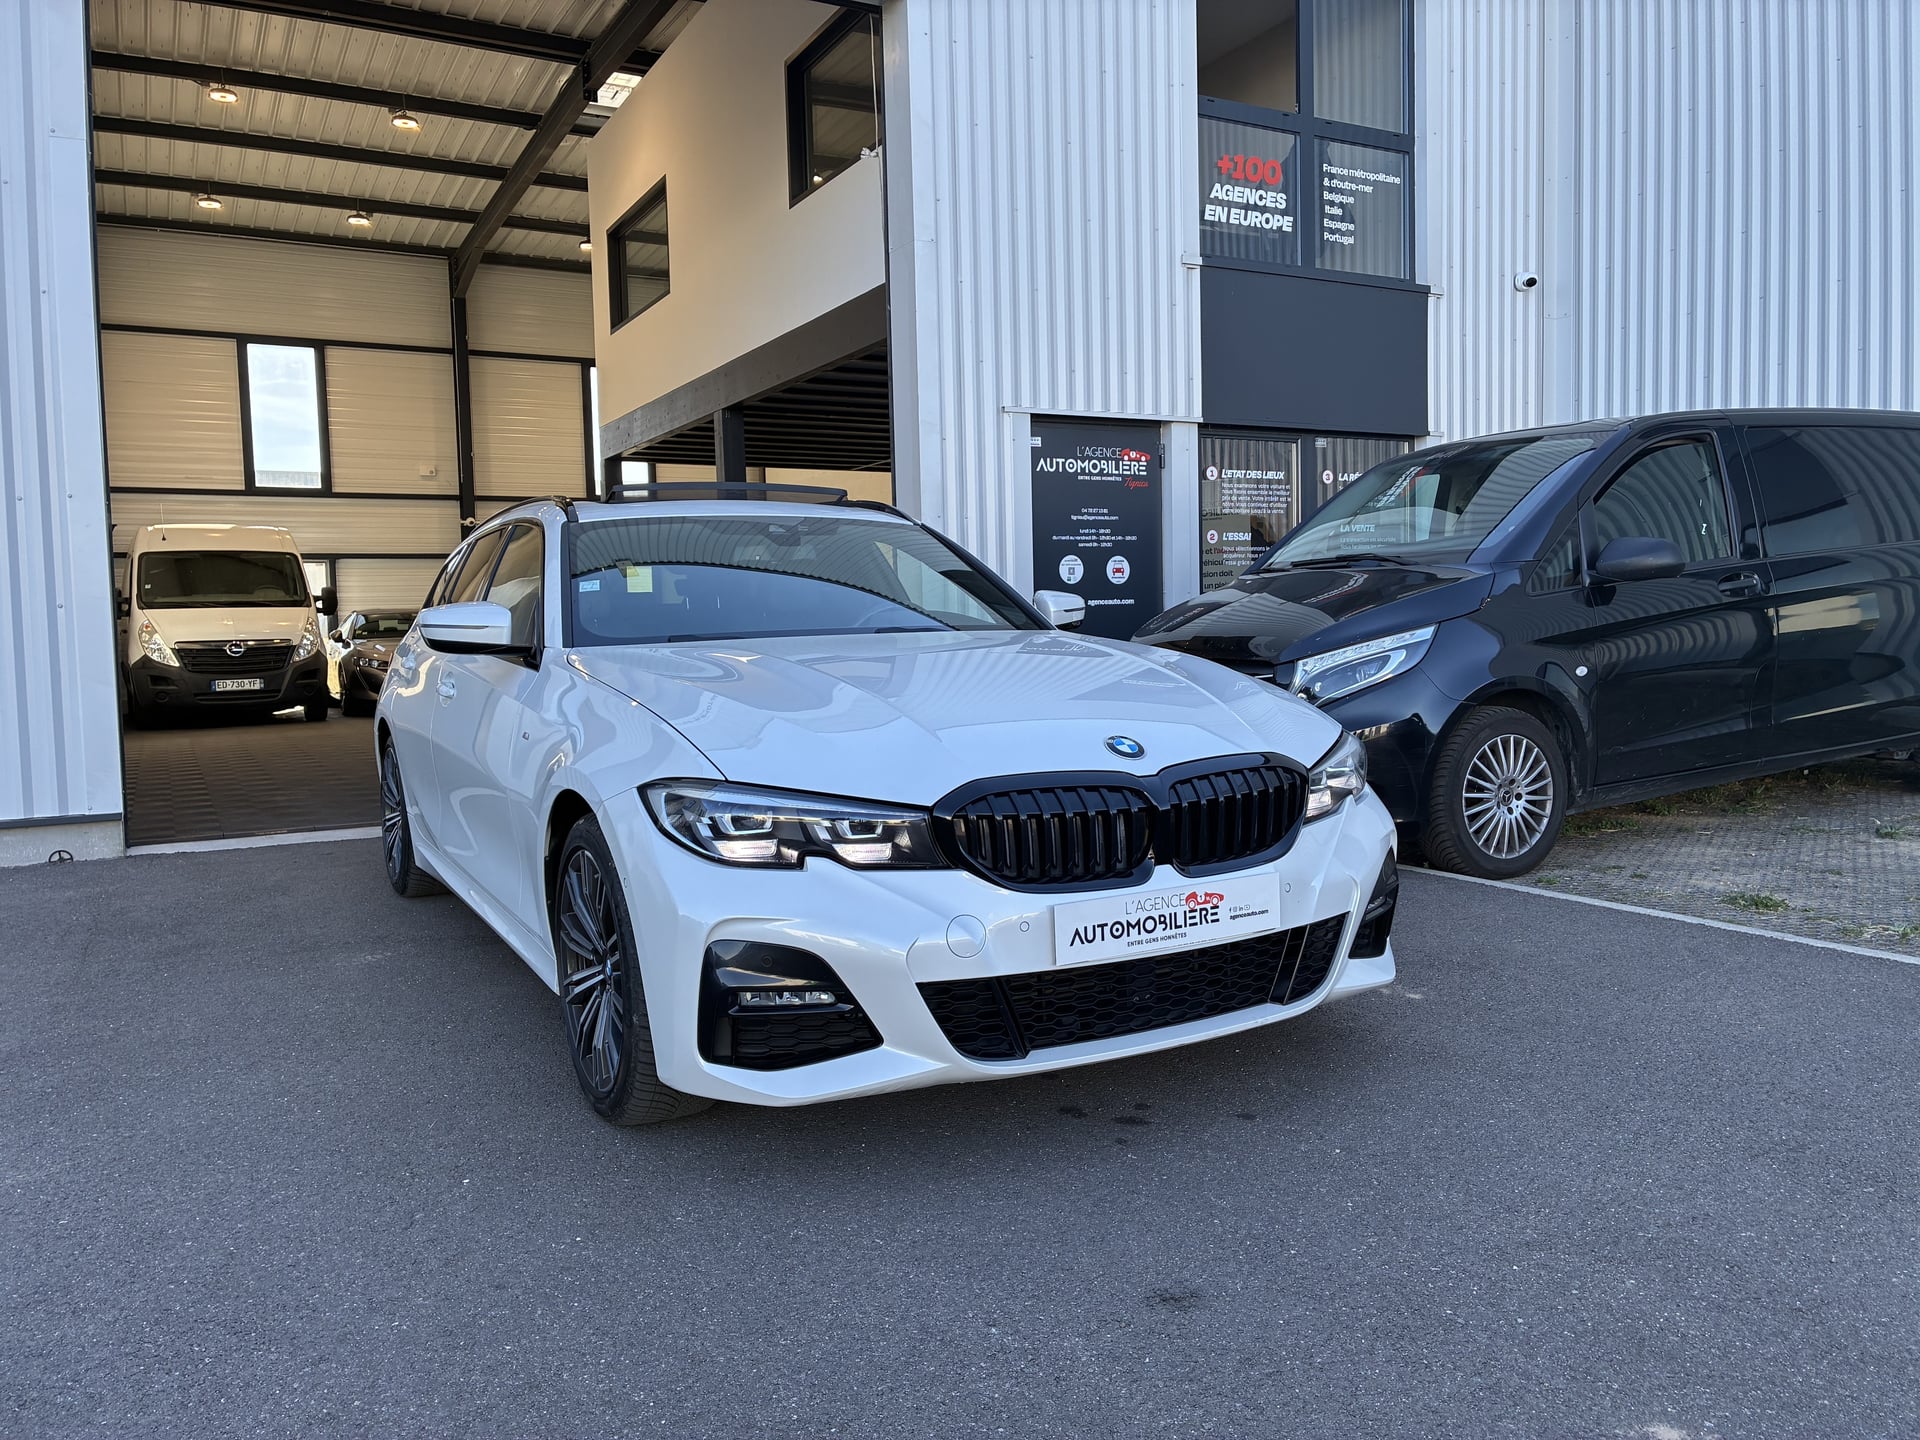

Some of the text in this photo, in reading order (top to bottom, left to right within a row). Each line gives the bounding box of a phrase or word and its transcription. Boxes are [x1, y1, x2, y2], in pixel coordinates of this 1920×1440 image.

[1217, 154, 1283, 186] +100
[1323, 164, 1401, 185] France métropolitaine
[1323, 177, 1374, 193] & d'outre-mer
[1209, 183, 1287, 209] AGENCES
[1323, 191, 1355, 205] Belgique
[1324, 205, 1343, 216] Italie
[1204, 204, 1294, 232] EN EUROPE
[1323, 218, 1355, 232] Espagne
[1323, 232, 1355, 245] Portugal
[1076, 446, 1122, 459] L'AGENCE
[1221, 469, 1246, 478] L'ETAT
[1246, 470, 1262, 478] DES
[1263, 471, 1285, 480] LIEUX
[1338, 472, 1349, 481] LA
[1349, 471, 1363, 482] RÉ
[1340, 524, 1376, 532] LA VENTE
[1222, 532, 1252, 541] L'ESSAI
[1125, 893, 1185, 915] L'AGENCE
[1229, 909, 1269, 920] agenceauto.com
[1127, 931, 1187, 948] ENTRE GENS HONNÊTES
